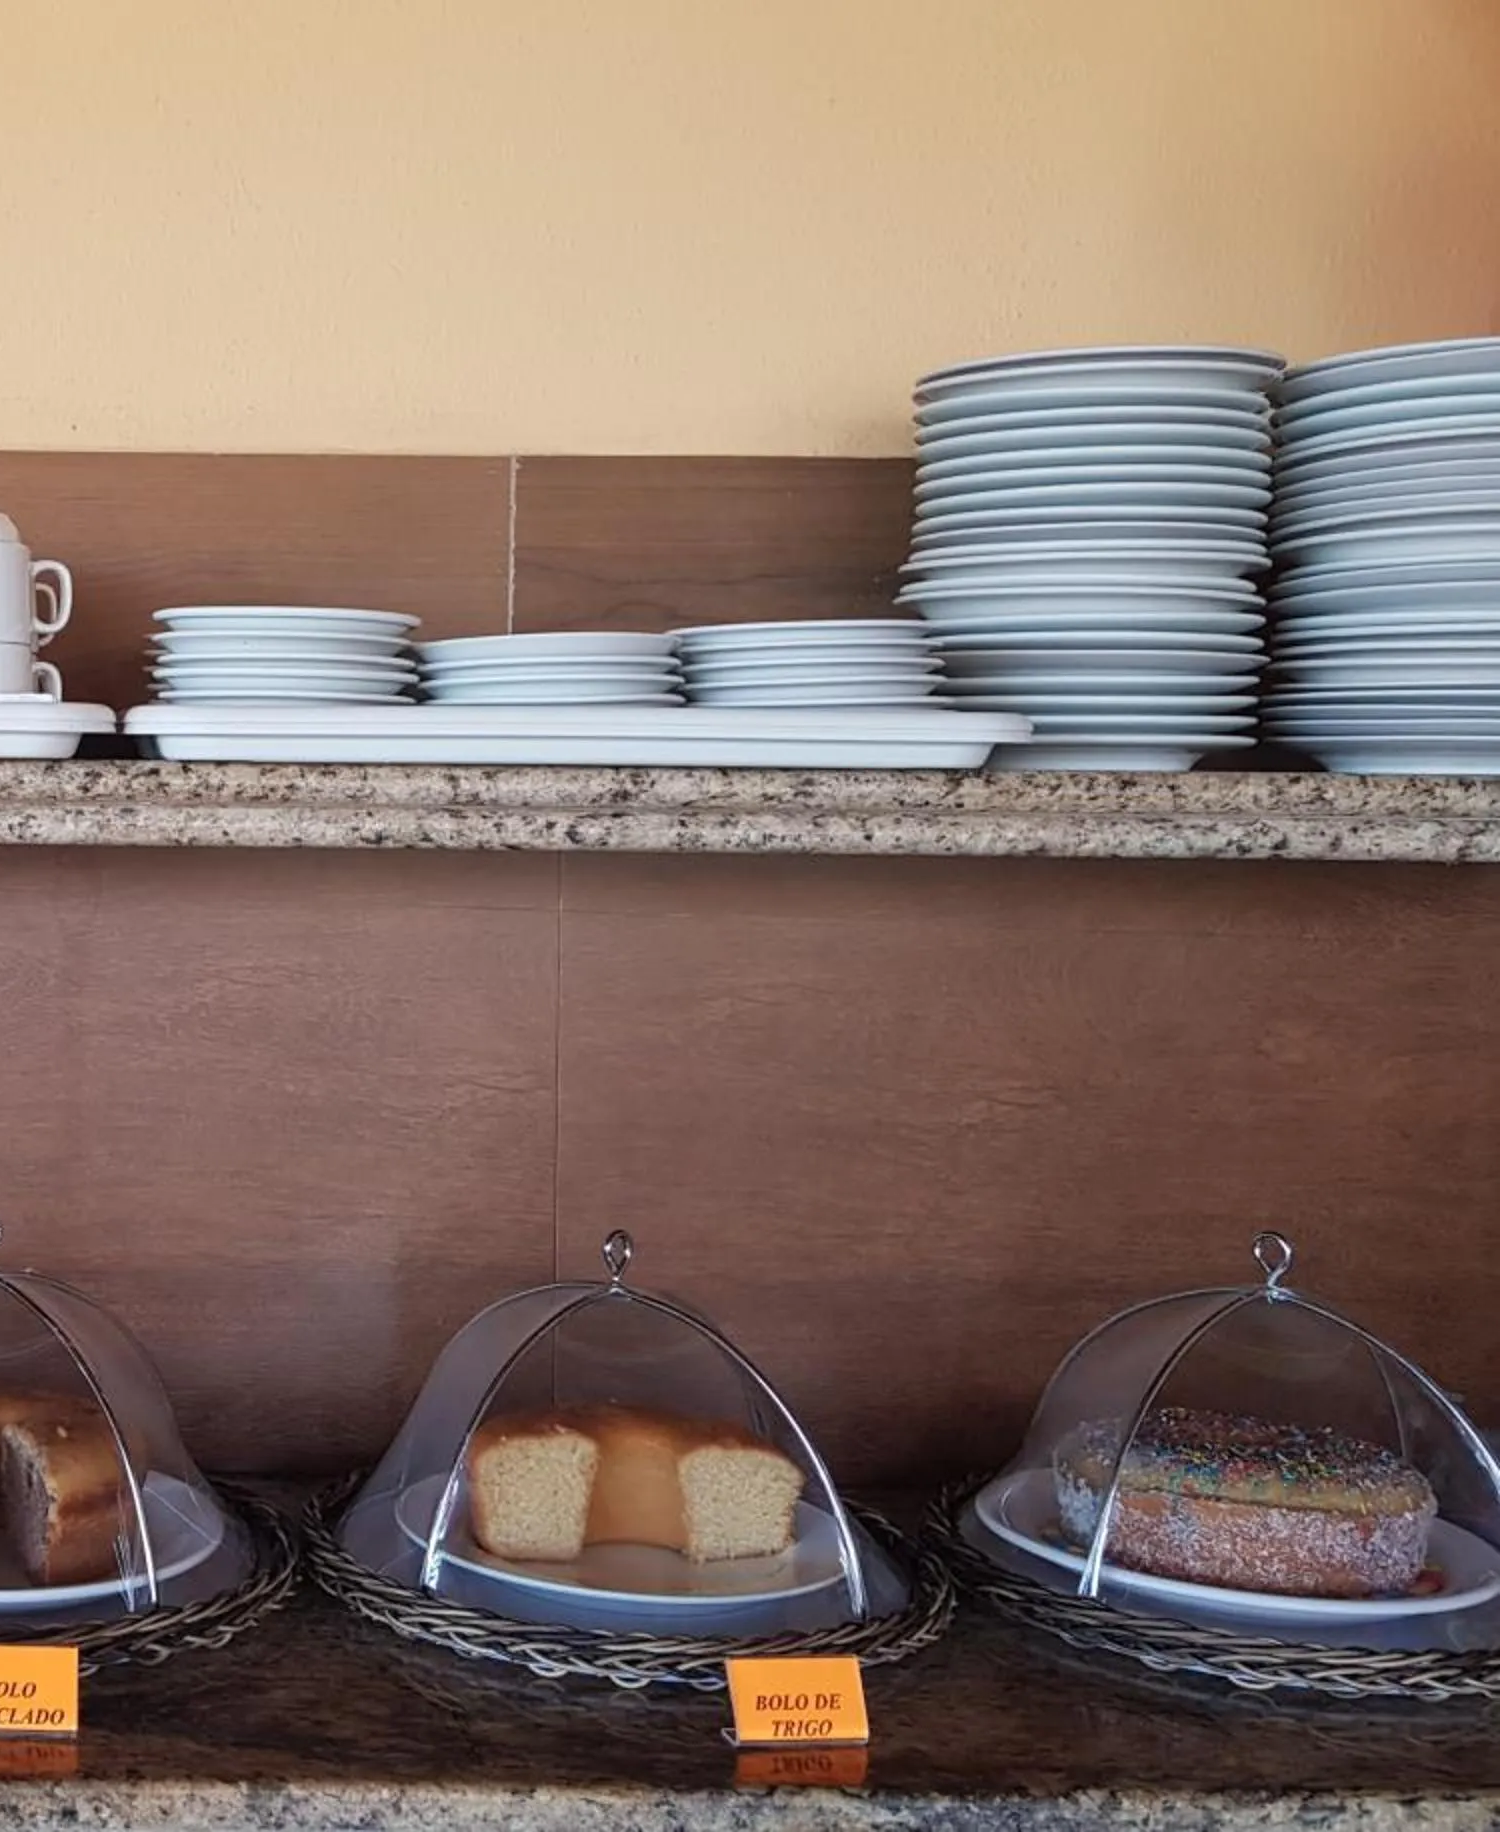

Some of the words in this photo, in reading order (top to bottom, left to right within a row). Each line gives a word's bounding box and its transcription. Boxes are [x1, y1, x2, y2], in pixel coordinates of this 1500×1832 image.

[755, 1694, 809, 1711] BOLO
[815, 1693, 842, 1710] DE
[771, 1719, 833, 1737] TRIGO
